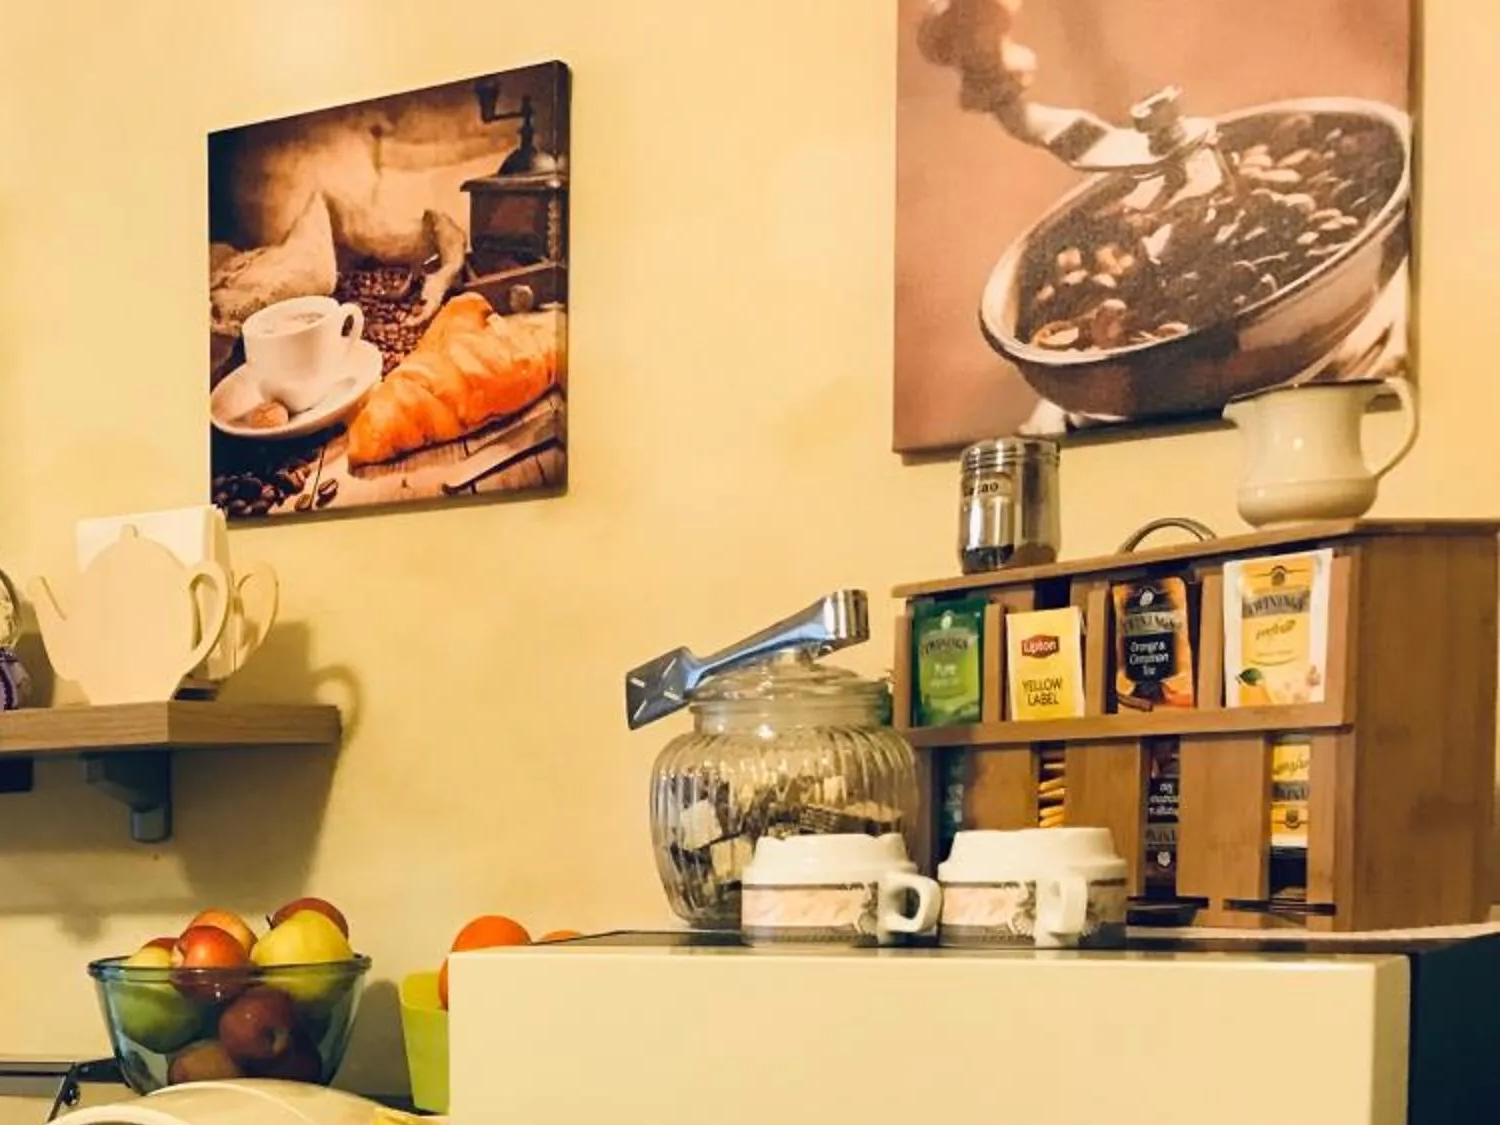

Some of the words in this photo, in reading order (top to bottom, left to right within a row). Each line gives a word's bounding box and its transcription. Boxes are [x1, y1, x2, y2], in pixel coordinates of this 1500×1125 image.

[1023, 640, 1058, 654] Lipton
[1021, 676, 1063, 693] YELLOW
[1027, 691, 1060, 706] LABEL
